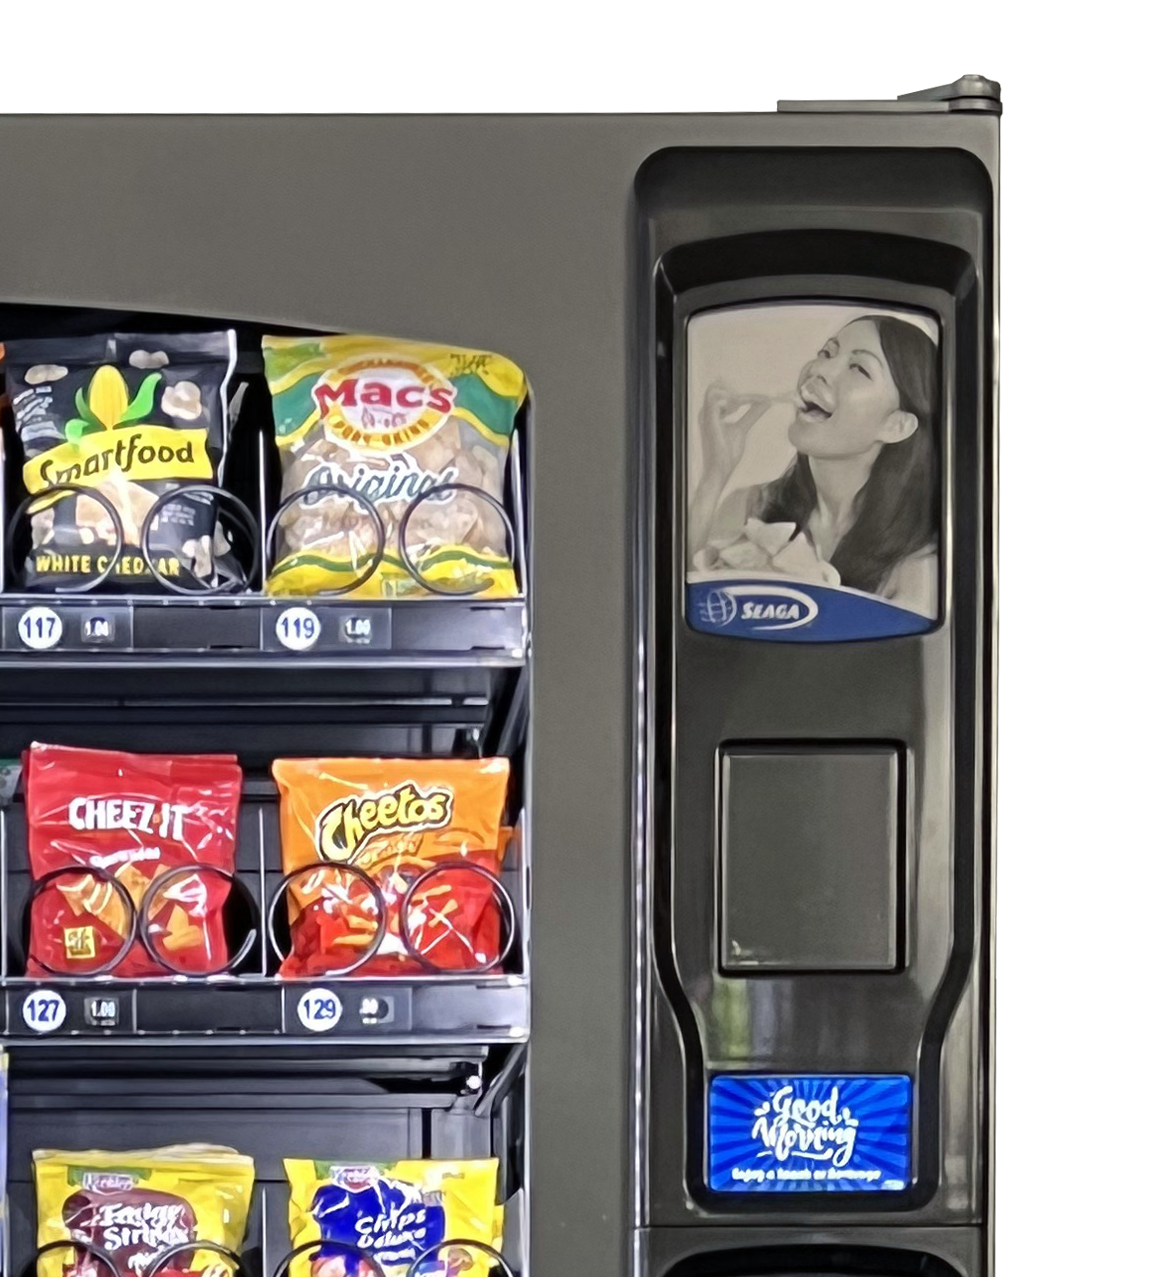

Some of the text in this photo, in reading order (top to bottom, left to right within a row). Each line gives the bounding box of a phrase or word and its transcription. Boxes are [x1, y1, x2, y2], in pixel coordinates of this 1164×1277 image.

[314, 378, 452, 419] Macs
[40, 433, 194, 488] Smartfood
[36, 554, 92, 573] WHITE
[741, 602, 800, 620] SEAGA
[24, 617, 56, 638] 117
[282, 617, 314, 638] 119
[320, 786, 452, 862] Cheetos
[27, 998, 59, 1021] 127
[303, 998, 336, 1020] 129
